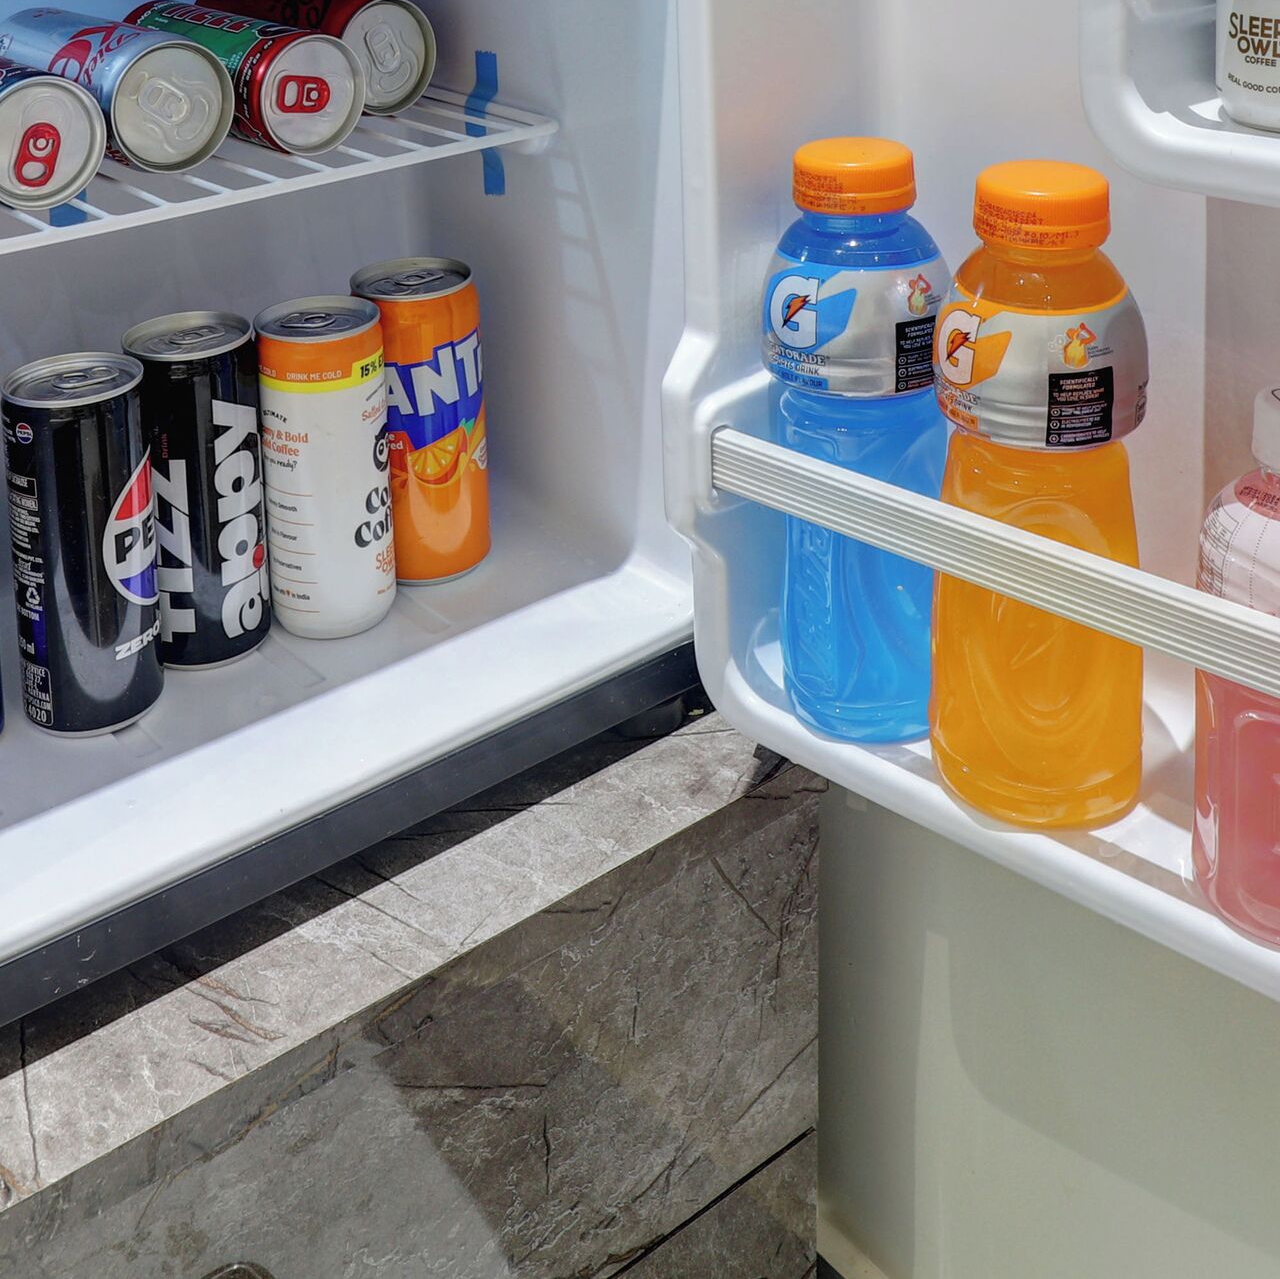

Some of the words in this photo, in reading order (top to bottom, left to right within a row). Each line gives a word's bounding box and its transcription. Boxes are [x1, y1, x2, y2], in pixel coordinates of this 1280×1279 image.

[1245, 55, 1277, 67] COFFEE
[1242, 81, 1264, 92] GOOD
[360, 359, 378, 378] 15%
[384, 331, 482, 417] ANT
[287, 372, 308, 381] DRINK
[310, 372, 321, 380] ME
[322, 370, 342, 379] COLD
[285, 432, 308, 443] Bold
[272, 442, 300, 457] Coffee
